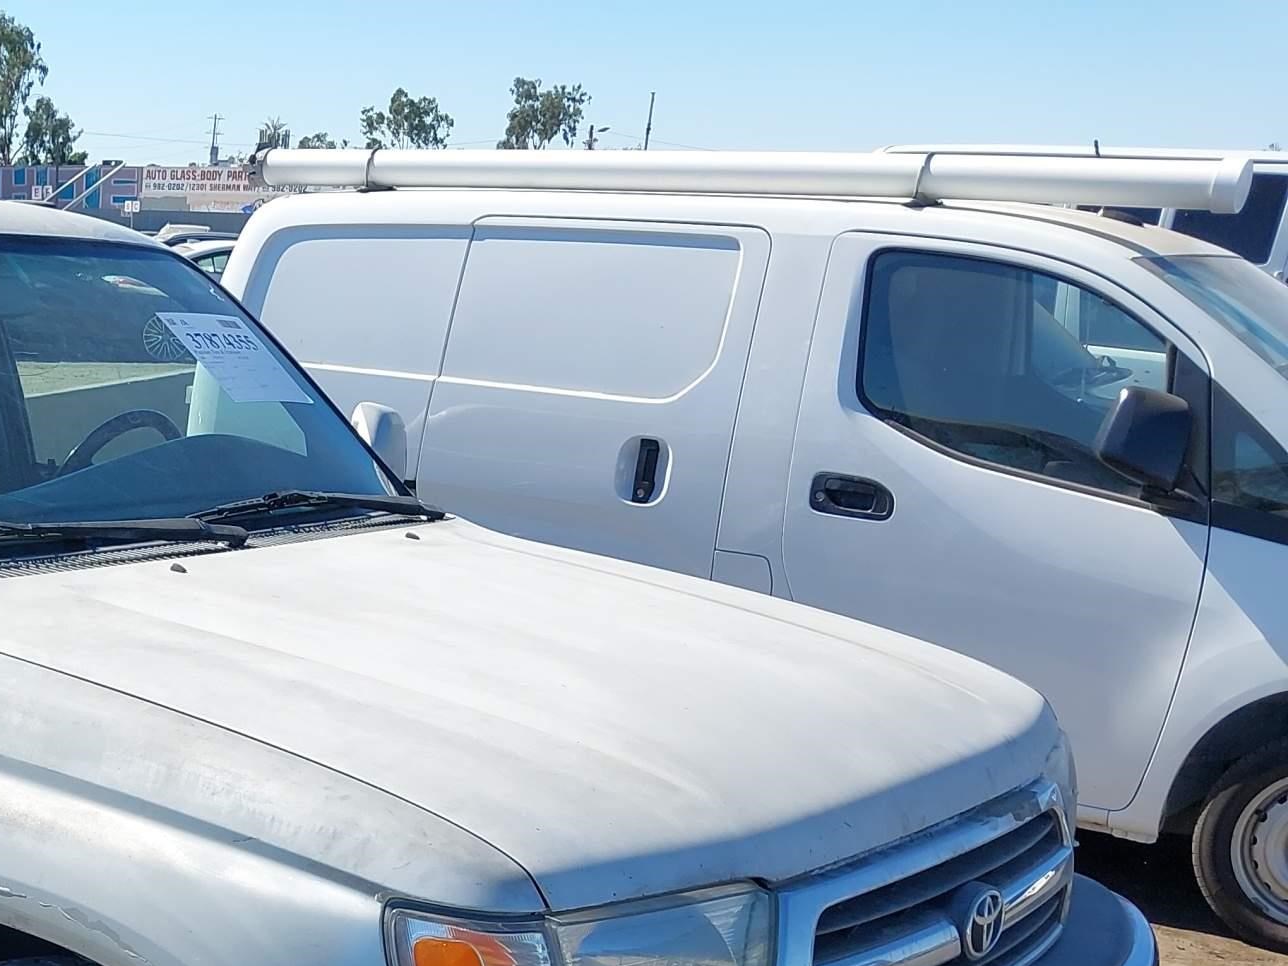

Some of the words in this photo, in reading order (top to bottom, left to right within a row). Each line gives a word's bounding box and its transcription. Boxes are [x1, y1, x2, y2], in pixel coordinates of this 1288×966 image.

[145, 169, 167, 181] AUTO
[227, 170, 249, 181] PART
[209, 183, 241, 192] SHERMAN
[185, 332, 259, 351] 37874355
